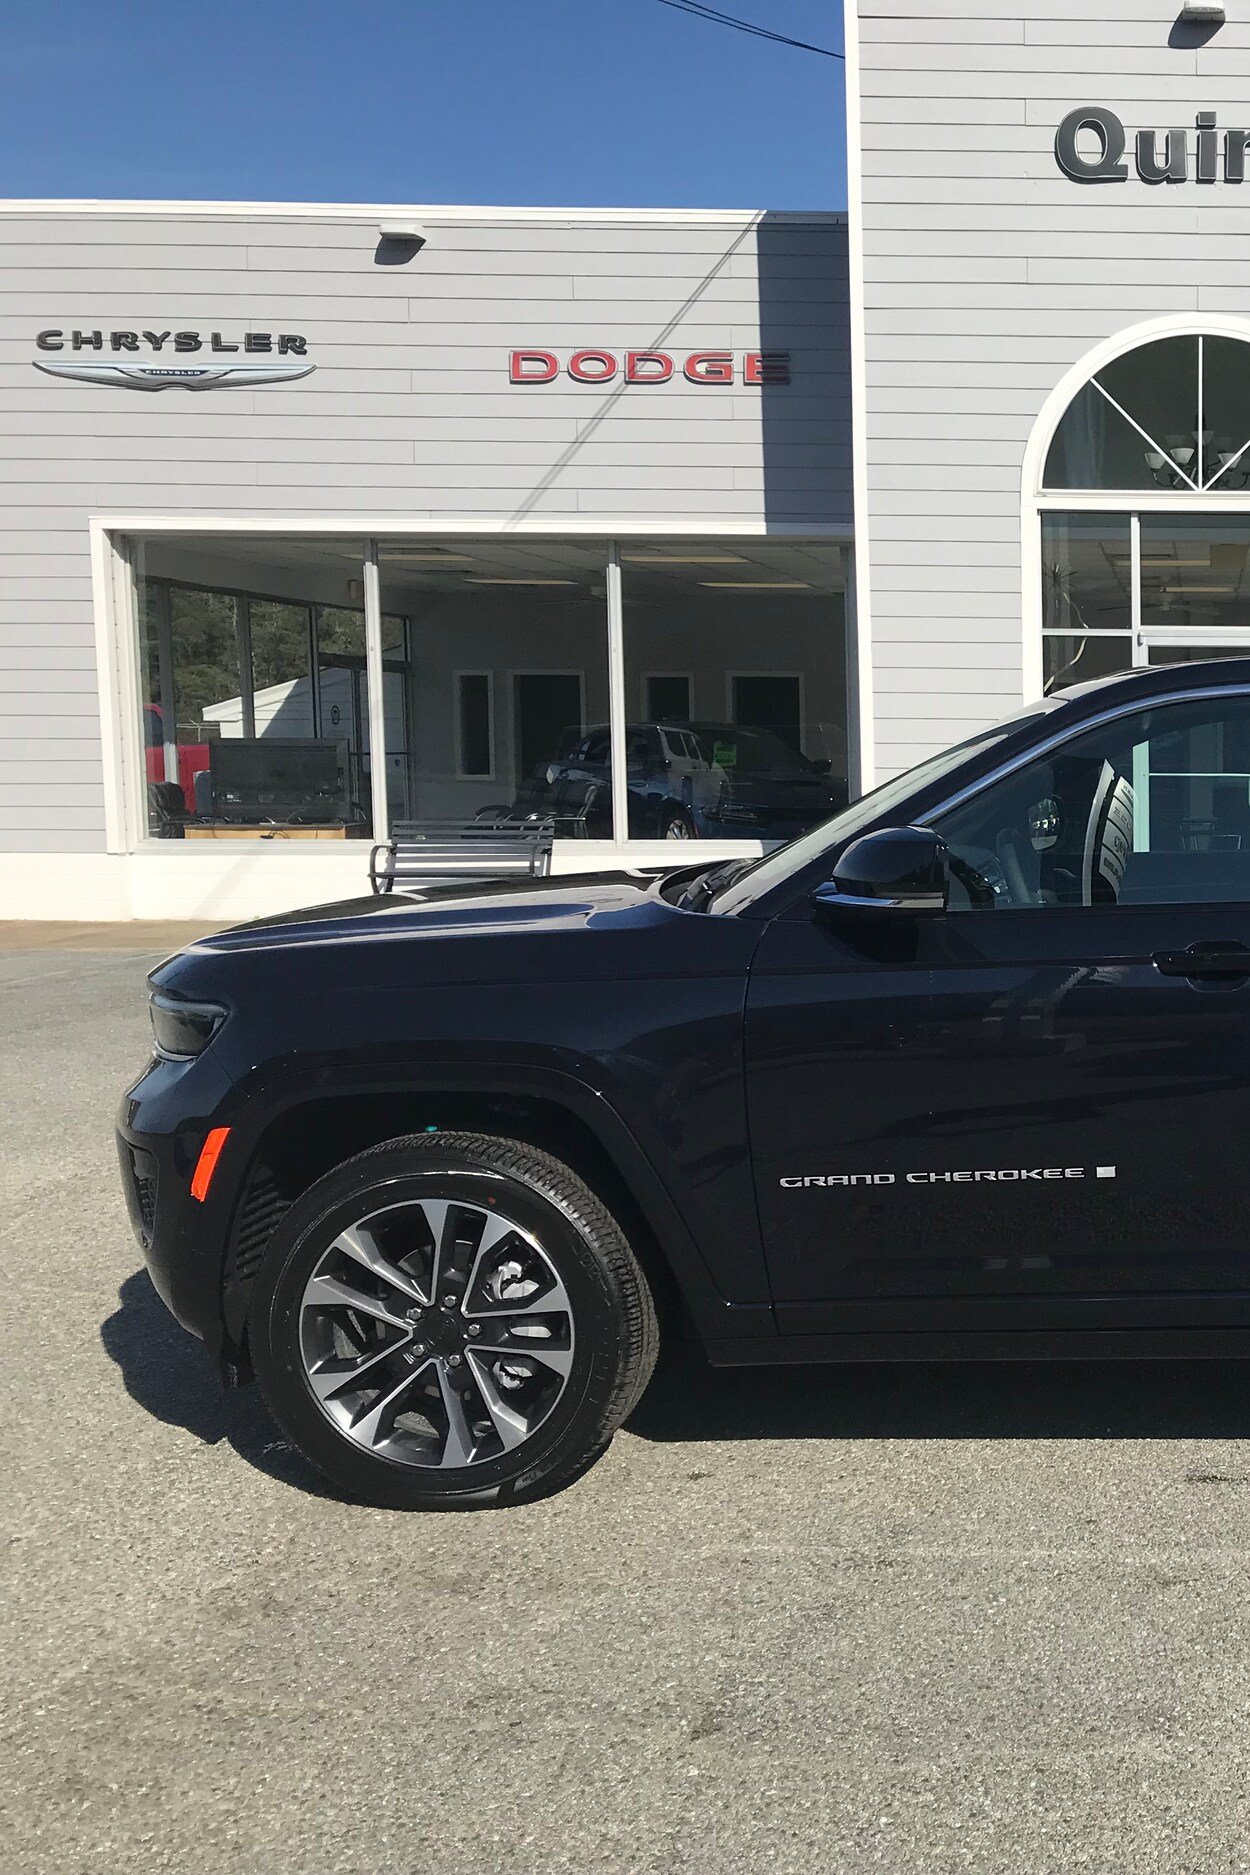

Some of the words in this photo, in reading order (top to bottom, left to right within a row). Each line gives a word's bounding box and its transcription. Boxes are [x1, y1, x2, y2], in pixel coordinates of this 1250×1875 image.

[36, 329, 308, 355] CHRYSLER
[509, 350, 790, 385] DODGE
[779, 1173, 896, 1188] GRAND
[906, 1167, 1085, 1183] CHEROKEE
